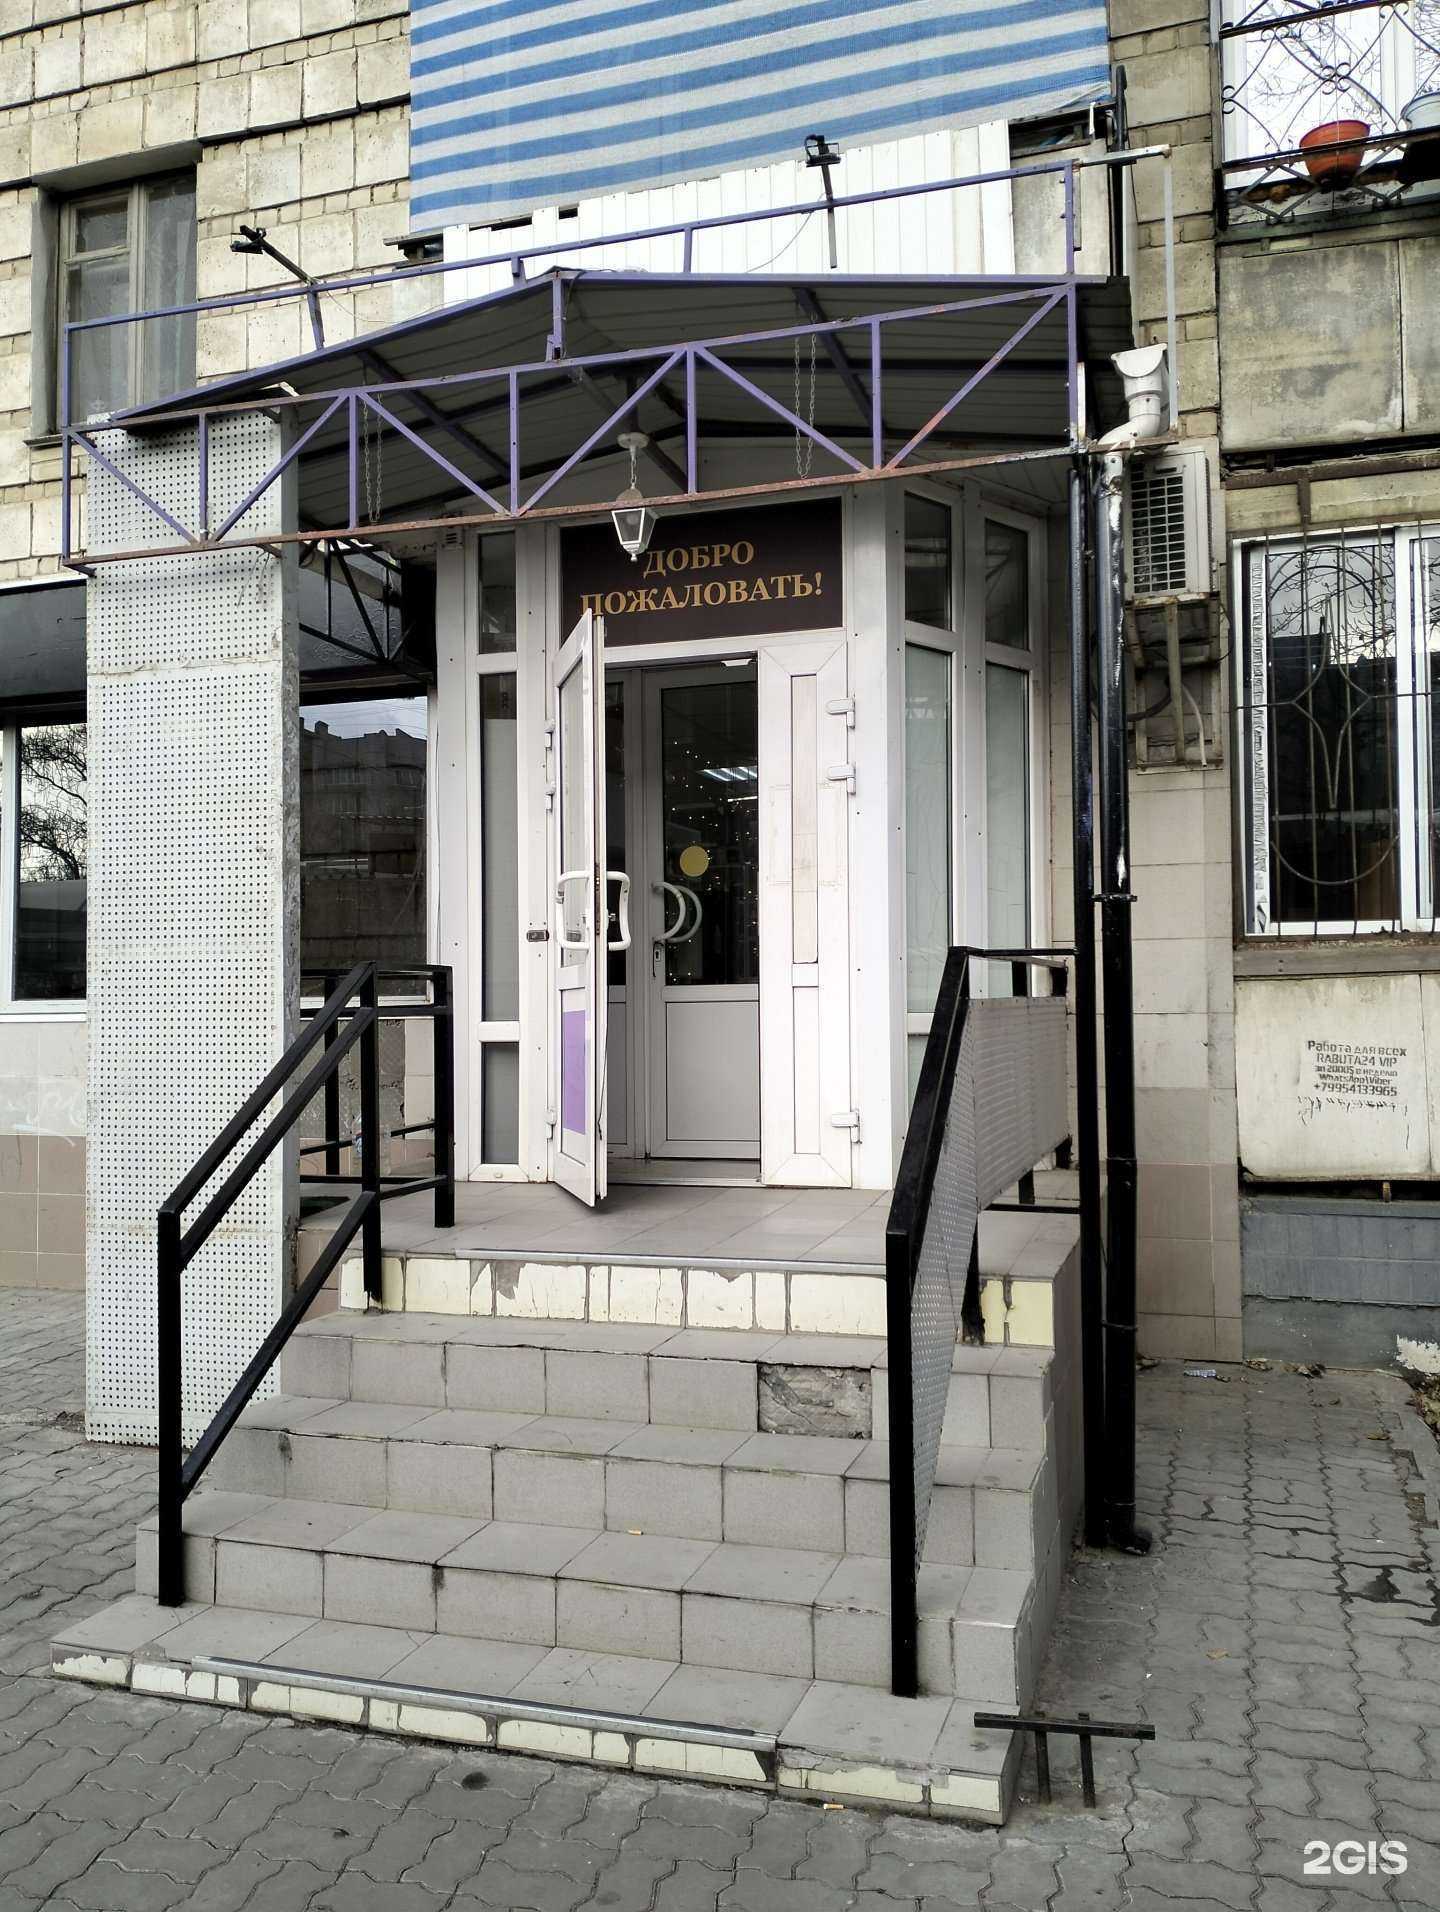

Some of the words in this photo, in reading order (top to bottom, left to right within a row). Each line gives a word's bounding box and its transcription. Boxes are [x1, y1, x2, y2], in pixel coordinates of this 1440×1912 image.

[643, 541, 754, 579] ДОБРО
[580, 571, 823, 617] ПОЖАЛОВАТЬ!
[1307, 1040, 1352, 1053] Работа
[1379, 1056, 1398, 1067] VIP
